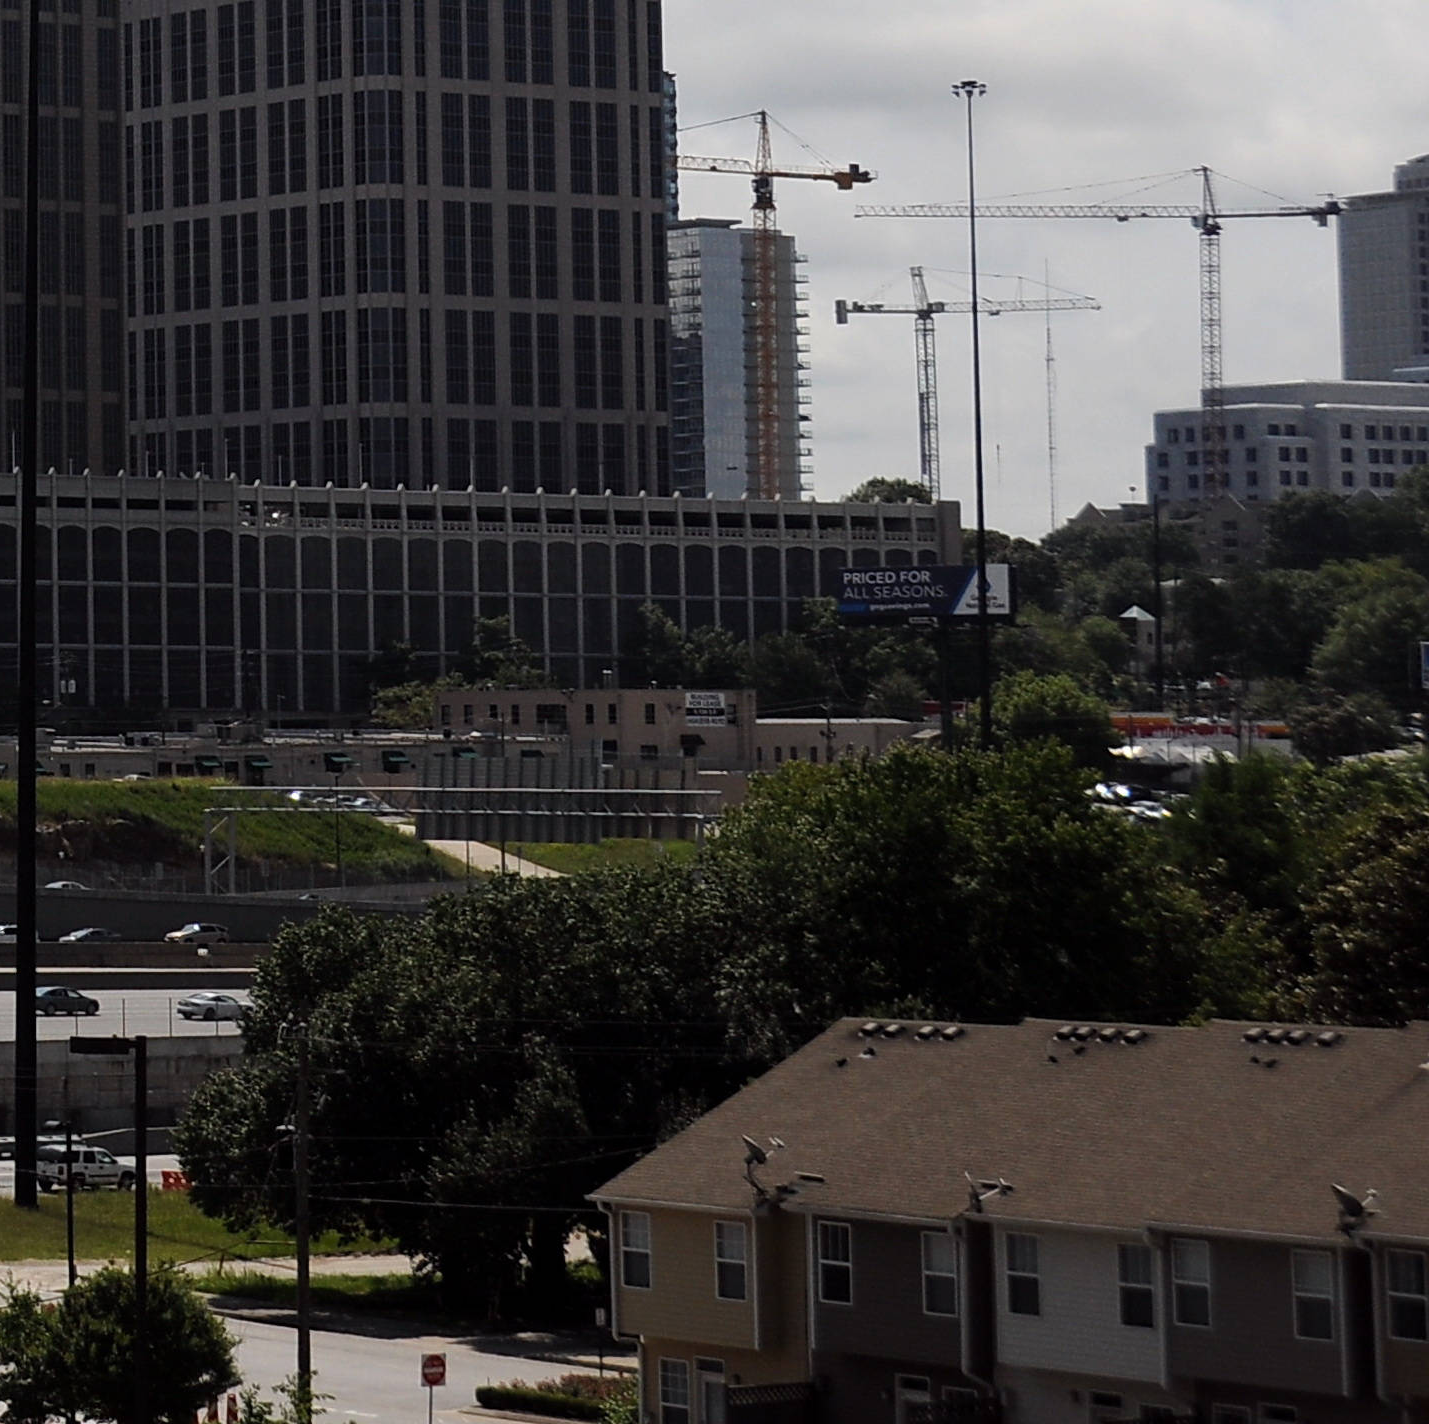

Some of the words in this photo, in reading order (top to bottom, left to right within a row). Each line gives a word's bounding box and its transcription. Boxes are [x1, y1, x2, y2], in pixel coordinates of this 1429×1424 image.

[843, 571, 896, 584] PRICED
[900, 570, 931, 584] FOR
[843, 586, 869, 599] ALL
